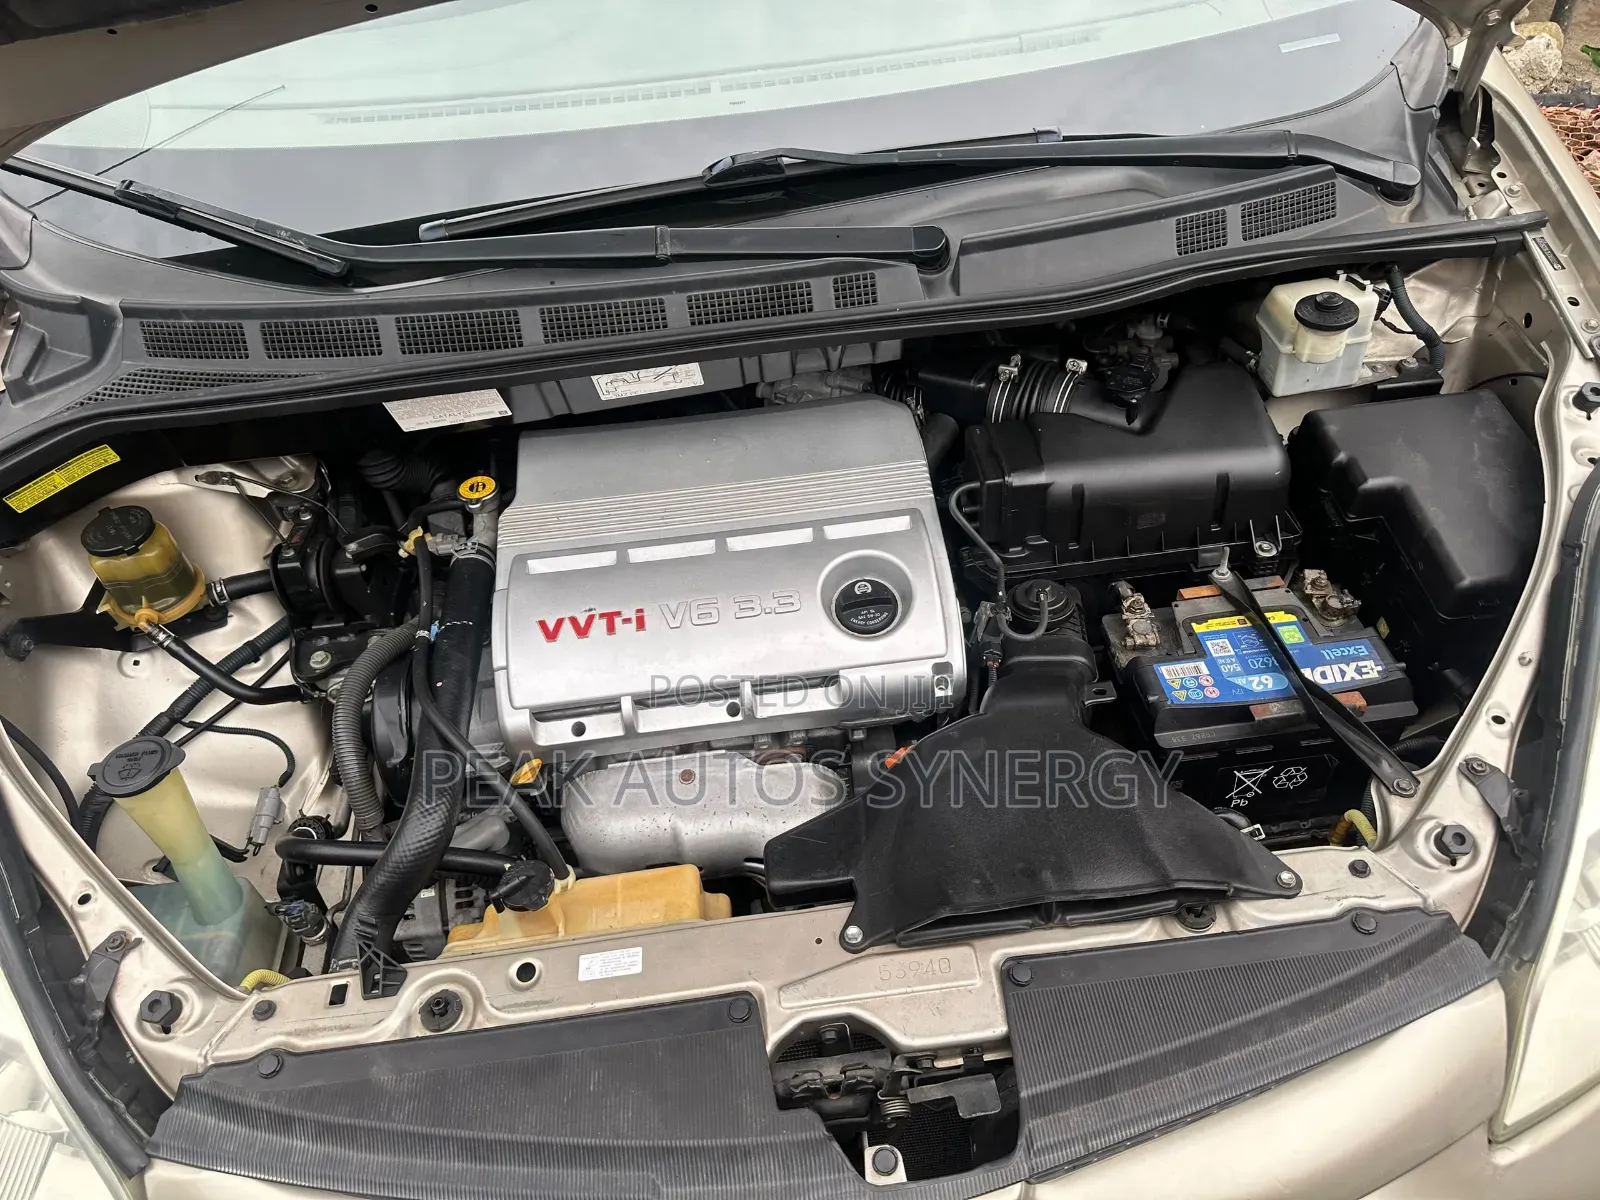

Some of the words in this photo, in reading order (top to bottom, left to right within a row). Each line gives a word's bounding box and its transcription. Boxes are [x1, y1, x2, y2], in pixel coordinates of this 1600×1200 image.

[536, 608, 646, 643] VVT-i
[659, 597, 719, 629] V6
[734, 590, 801, 619] 3.3
[1321, 645, 1369, 660] Excell
[1221, 663, 1241, 672] 540
[1248, 675, 1273, 690] 62
[1230, 798, 1249, 808] Pb
